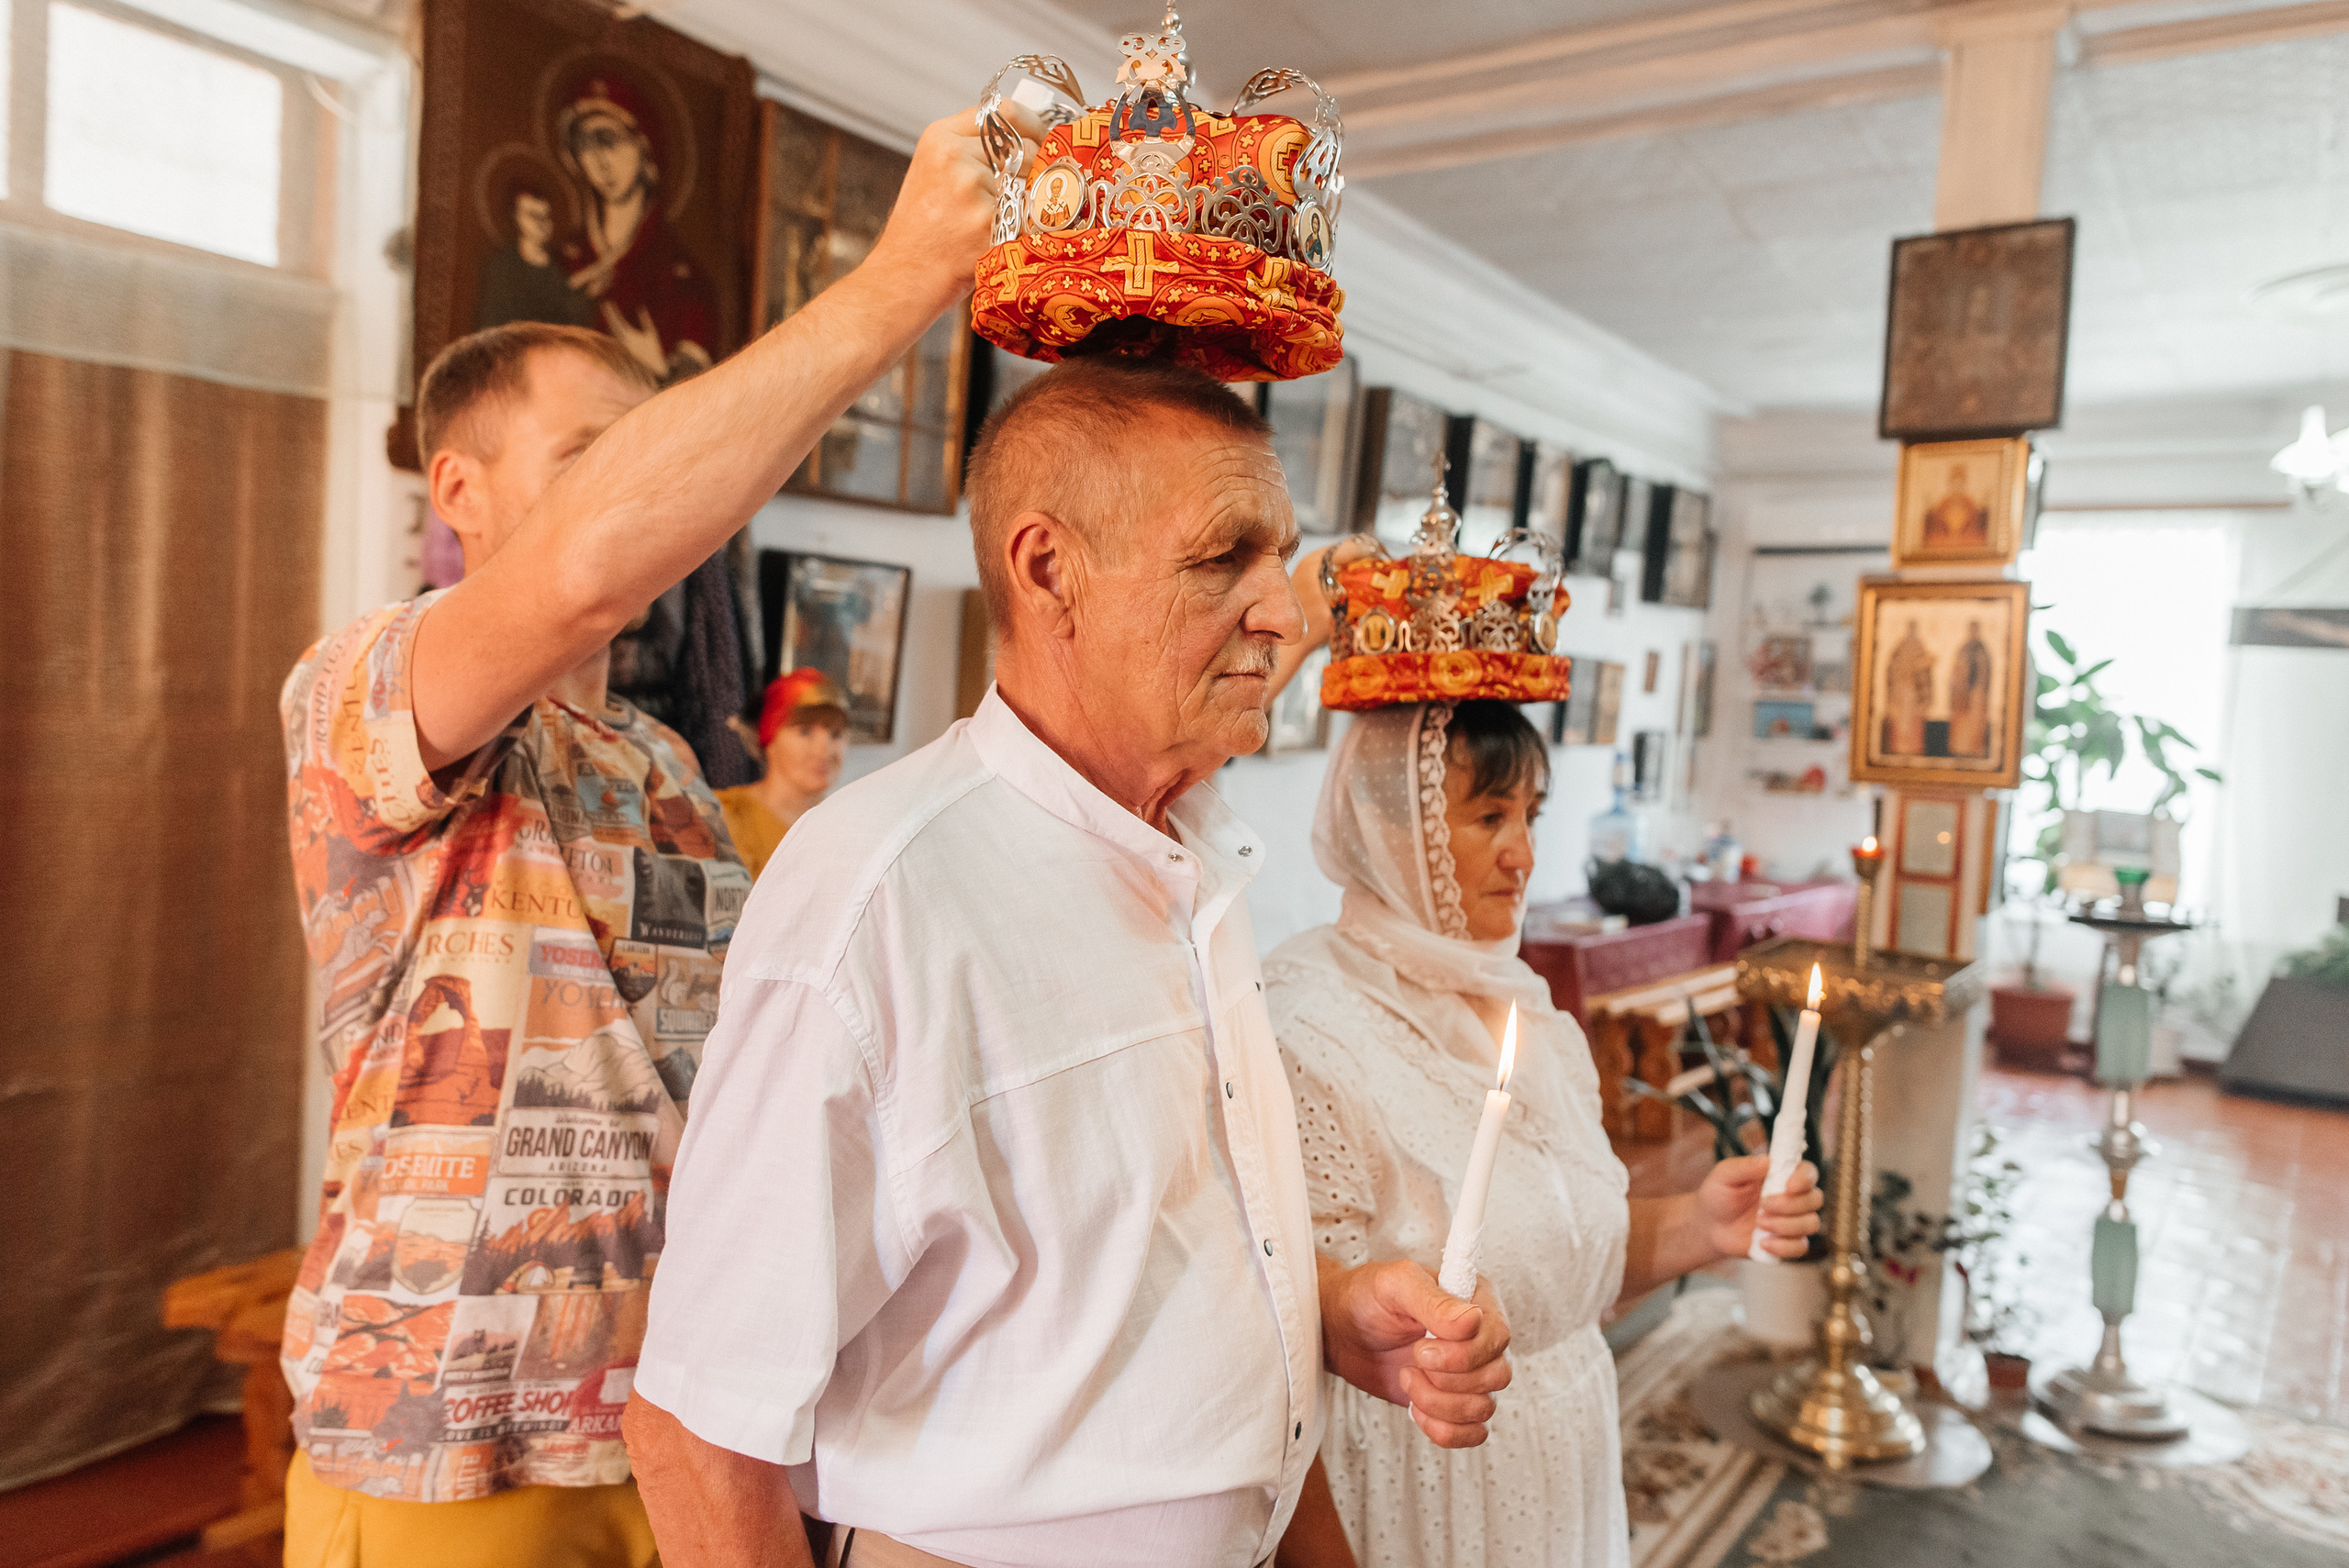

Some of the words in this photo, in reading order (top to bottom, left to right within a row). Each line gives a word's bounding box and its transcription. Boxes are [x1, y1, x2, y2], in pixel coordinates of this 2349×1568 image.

[491, 889, 581, 918] KENTU
[425, 929, 516, 957] RCHES
[506, 1126, 576, 1158] GRAND
[579, 1128, 654, 1161] CANYON
[383, 1154, 477, 1180] OSEMITE
